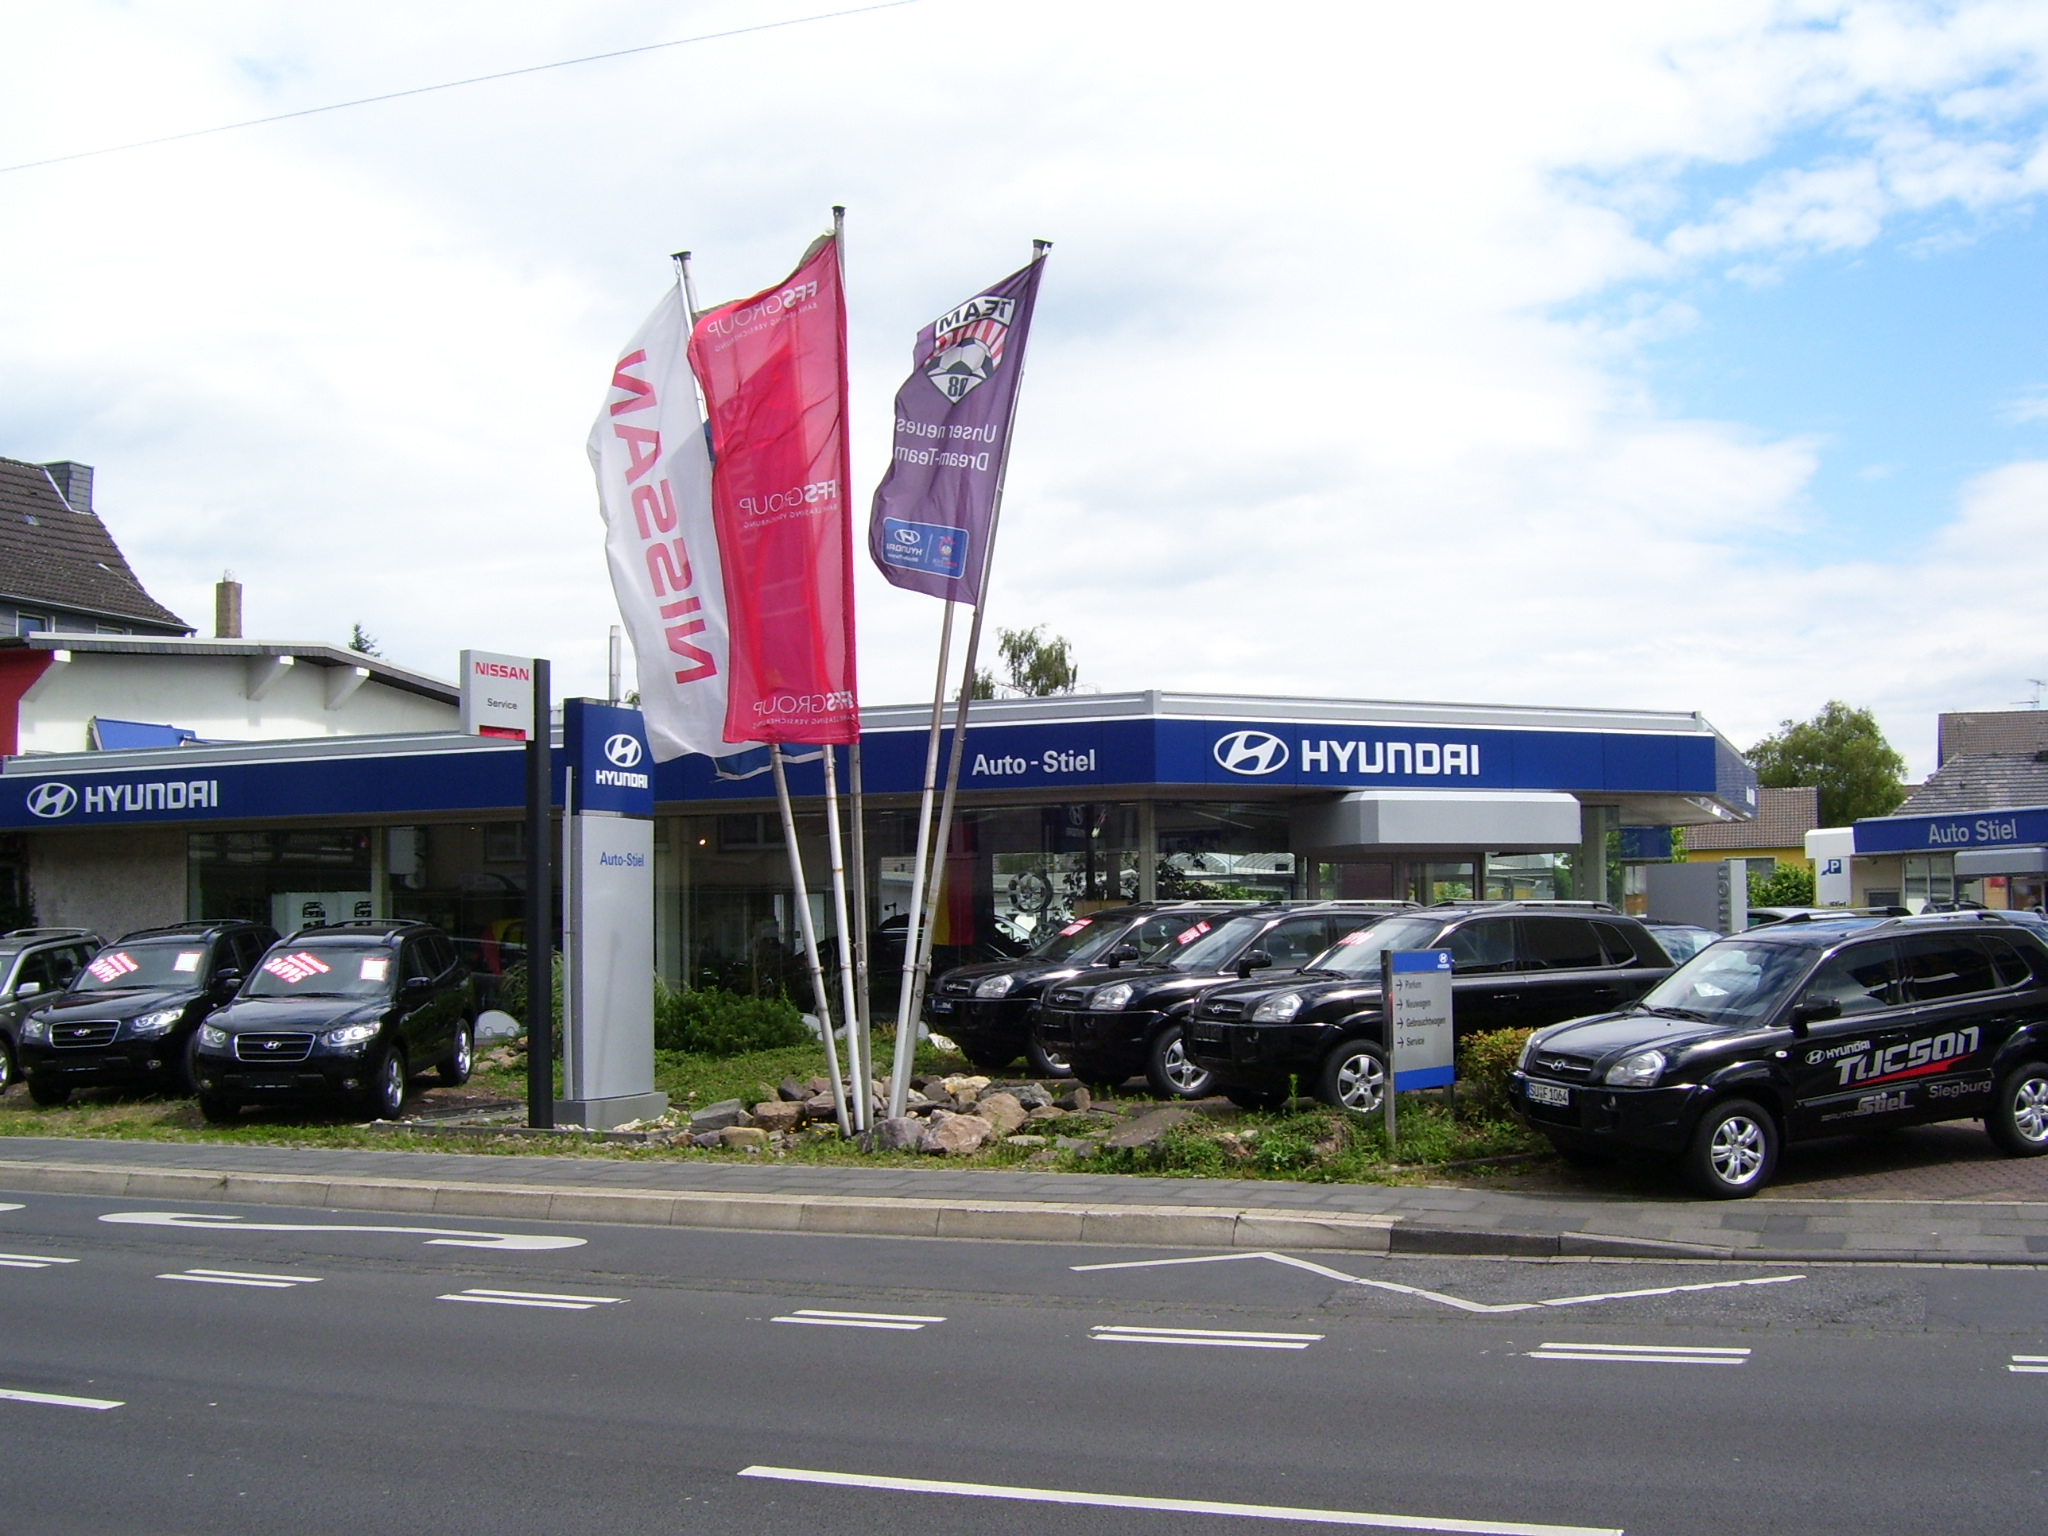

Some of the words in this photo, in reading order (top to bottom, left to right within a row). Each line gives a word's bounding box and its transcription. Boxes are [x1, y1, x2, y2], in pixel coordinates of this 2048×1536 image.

[475, 661, 530, 681] NISSAN
[487, 697, 518, 710] Service
[1042, 748, 1096, 773] Stiel
[1301, 739, 1480, 776] HYUNDAI
[595, 769, 649, 790] HYUNDAI
[84, 780, 219, 813] HYUNDAI
[1927, 823, 1970, 844] Auto
[1974, 818, 2018, 842] Stiel
[600, 851, 645, 868] Auto-Stiel
[1826, 1039, 1871, 1059] HYUNDAI
[1834, 1026, 1980, 1086] TUCSON
[1928, 1080, 1992, 1099] Siegburg
